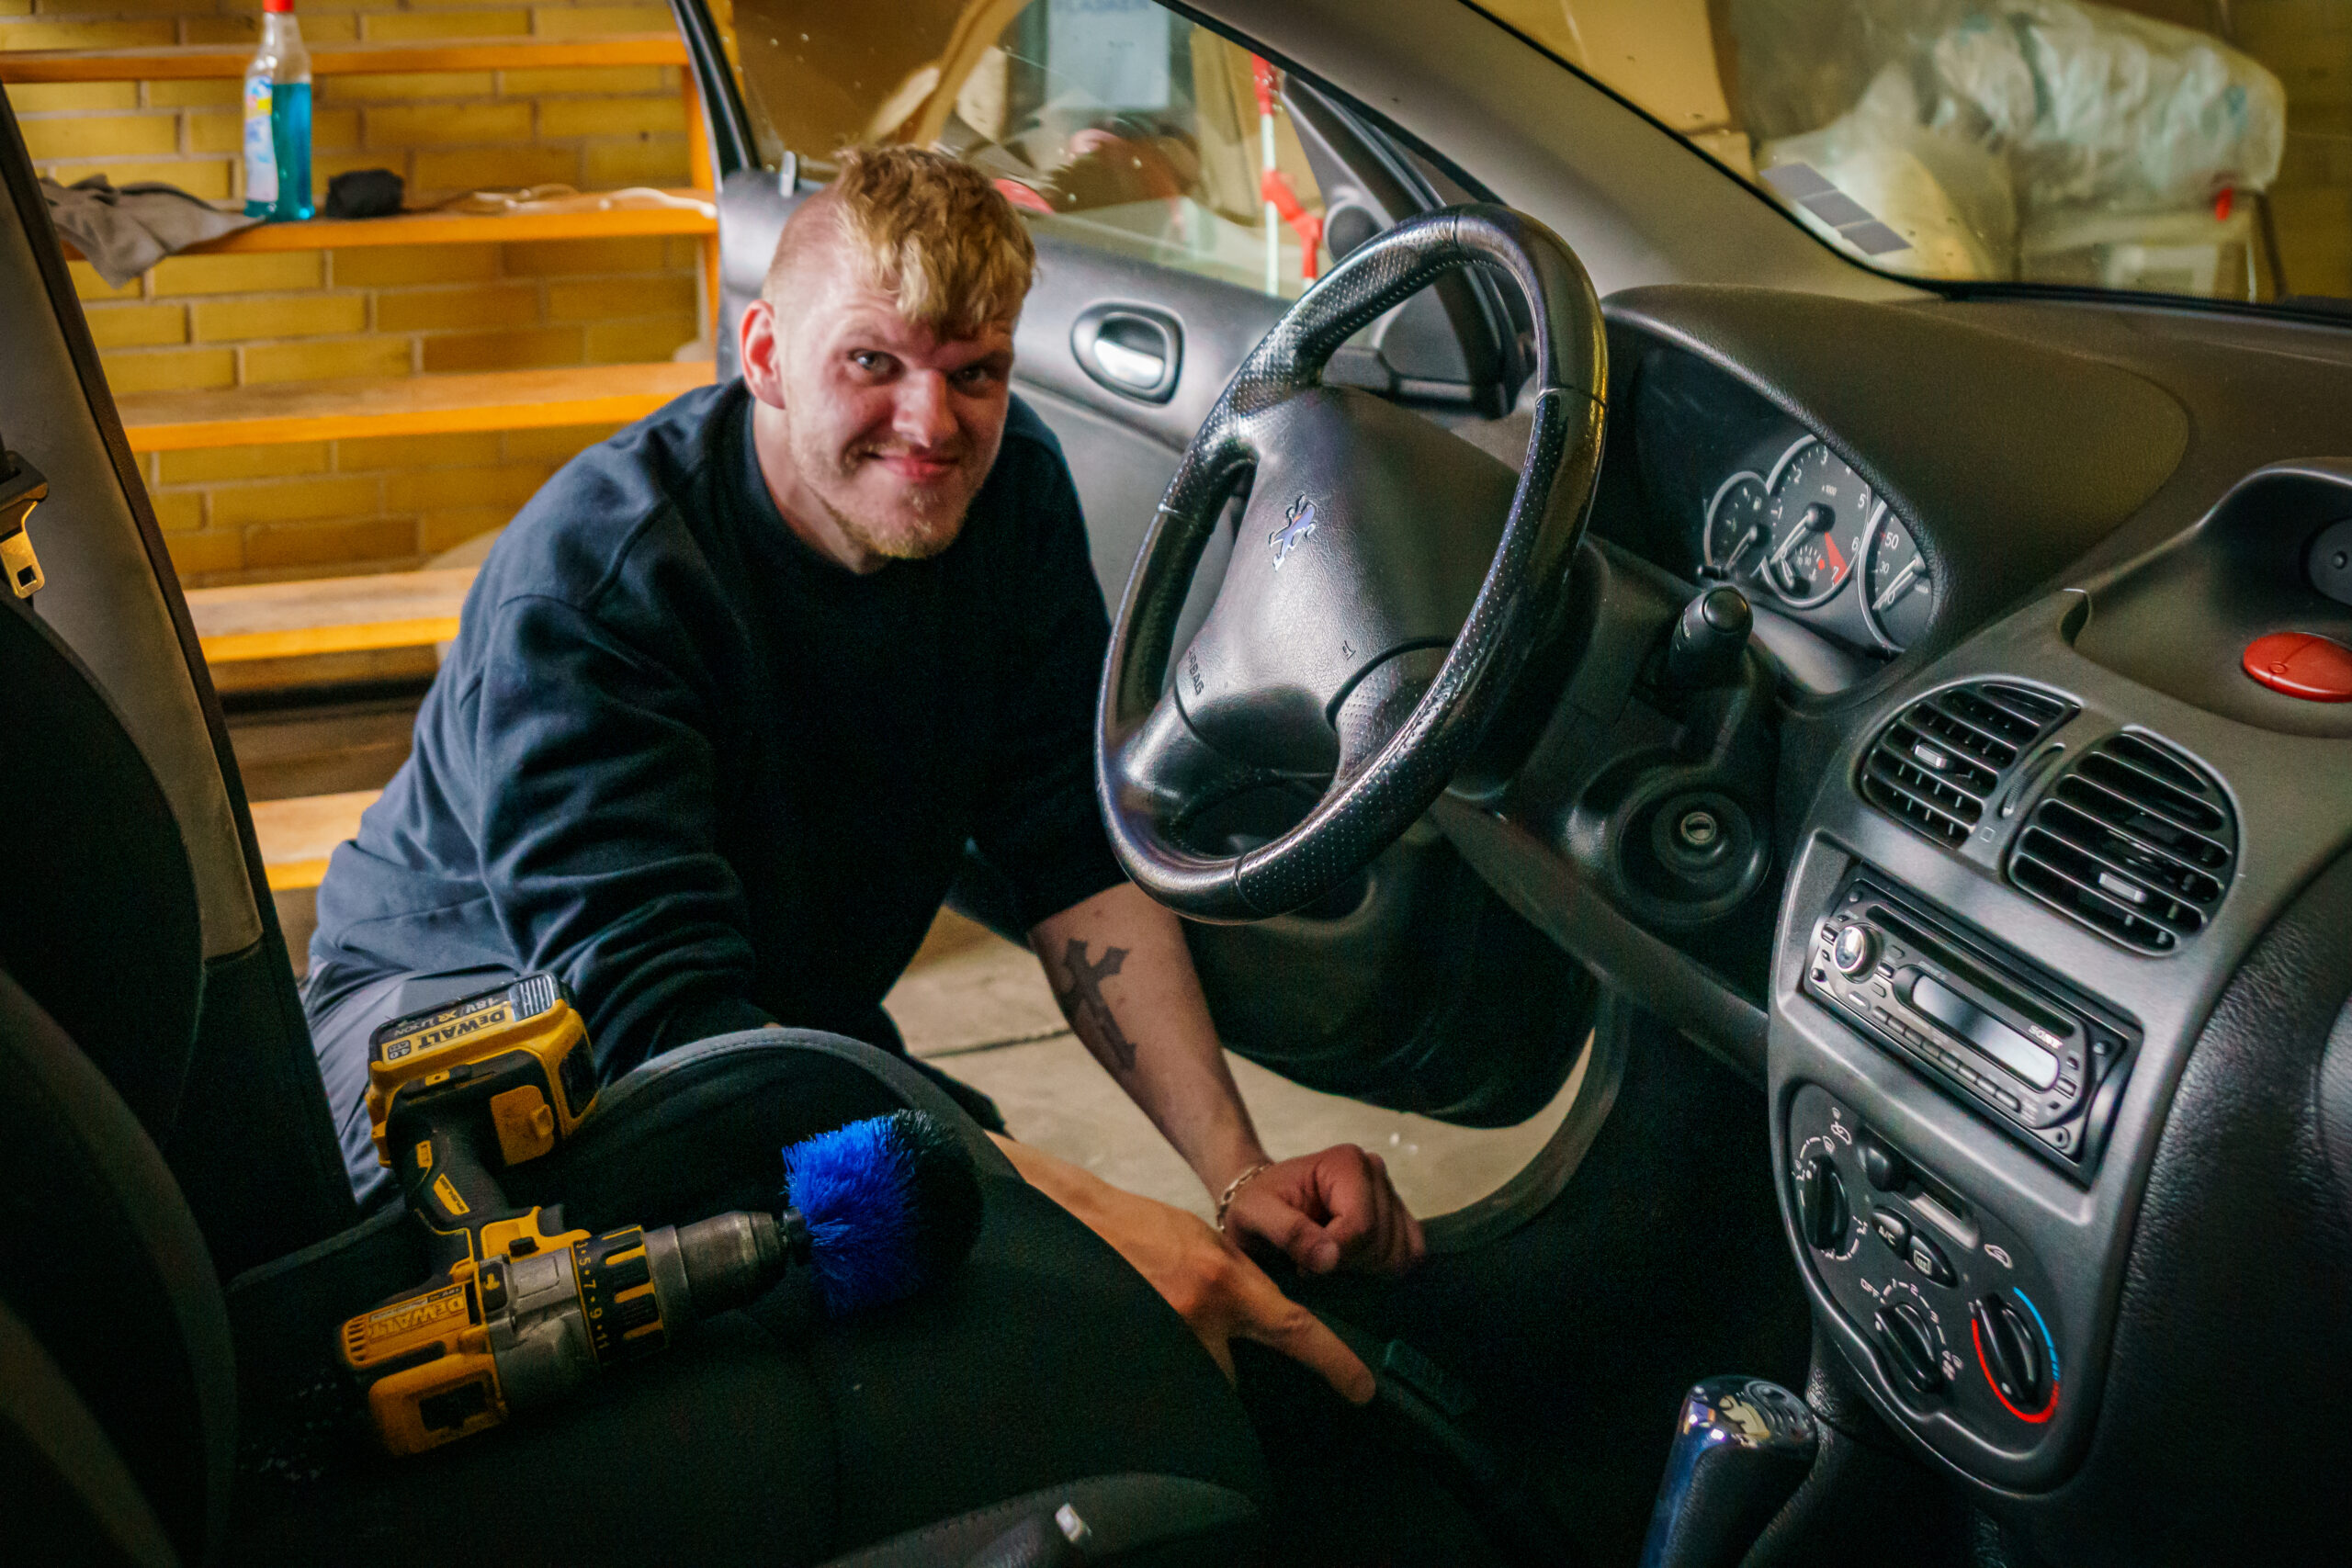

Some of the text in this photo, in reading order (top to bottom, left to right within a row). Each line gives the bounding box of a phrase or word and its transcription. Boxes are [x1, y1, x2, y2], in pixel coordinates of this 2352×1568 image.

[1793, 469, 1802, 483] 2
[1858, 493, 1866, 508] 5
[1851, 536, 1859, 551] 6
[1885, 532, 1899, 549] 50
[1880, 560, 1890, 574] 30
[465, 997, 502, 1015] 18V
[418, 1010, 506, 1050] DEWALT
[2029, 1025, 2064, 1049] SONY
[1879, 1225, 1896, 1247] A/C
[579, 1257, 591, 1266] 5
[583, 1279, 596, 1289] 7
[1910, 1283, 1918, 1297] 2
[1930, 1310, 1939, 1324] 3
[369, 1296, 464, 1338] DEWALT
[589, 1307, 603, 1319] 9
